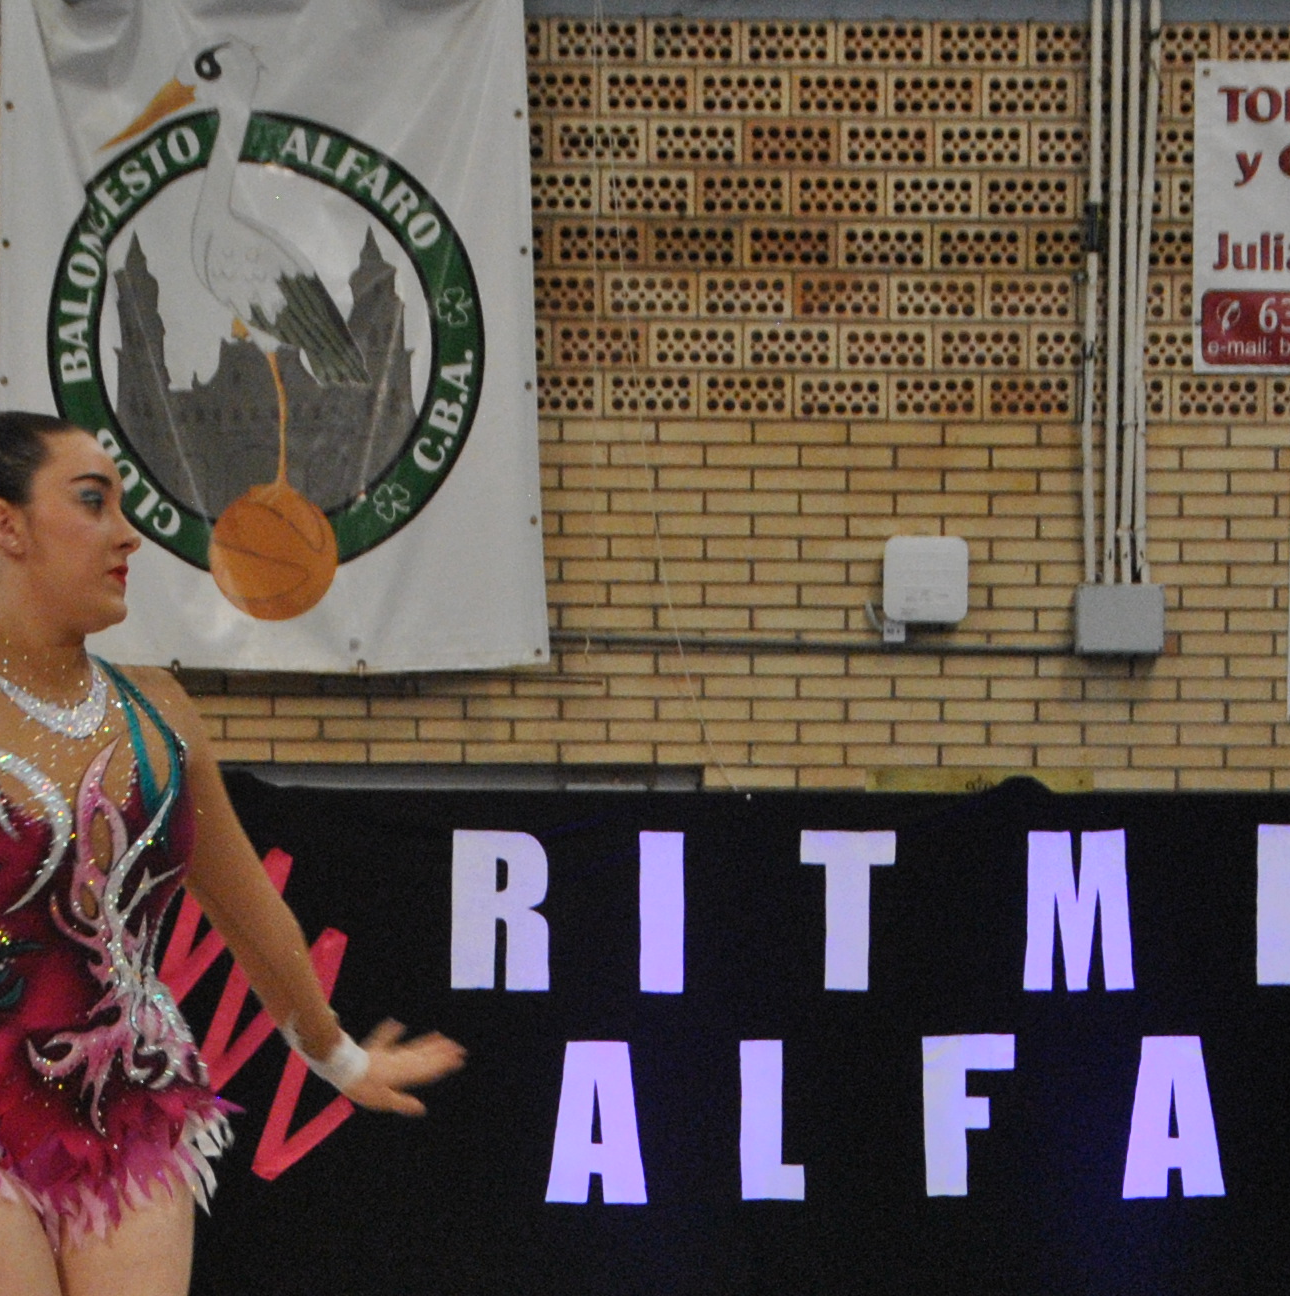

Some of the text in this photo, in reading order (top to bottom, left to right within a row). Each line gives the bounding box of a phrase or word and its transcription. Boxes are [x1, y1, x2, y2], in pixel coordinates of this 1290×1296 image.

[281, 126, 441, 249] ALFARO
[1234, 151, 1263, 188] y
[1207, 338, 1272, 358] e-mail:
[412, 350, 475, 473] C.B.A.
